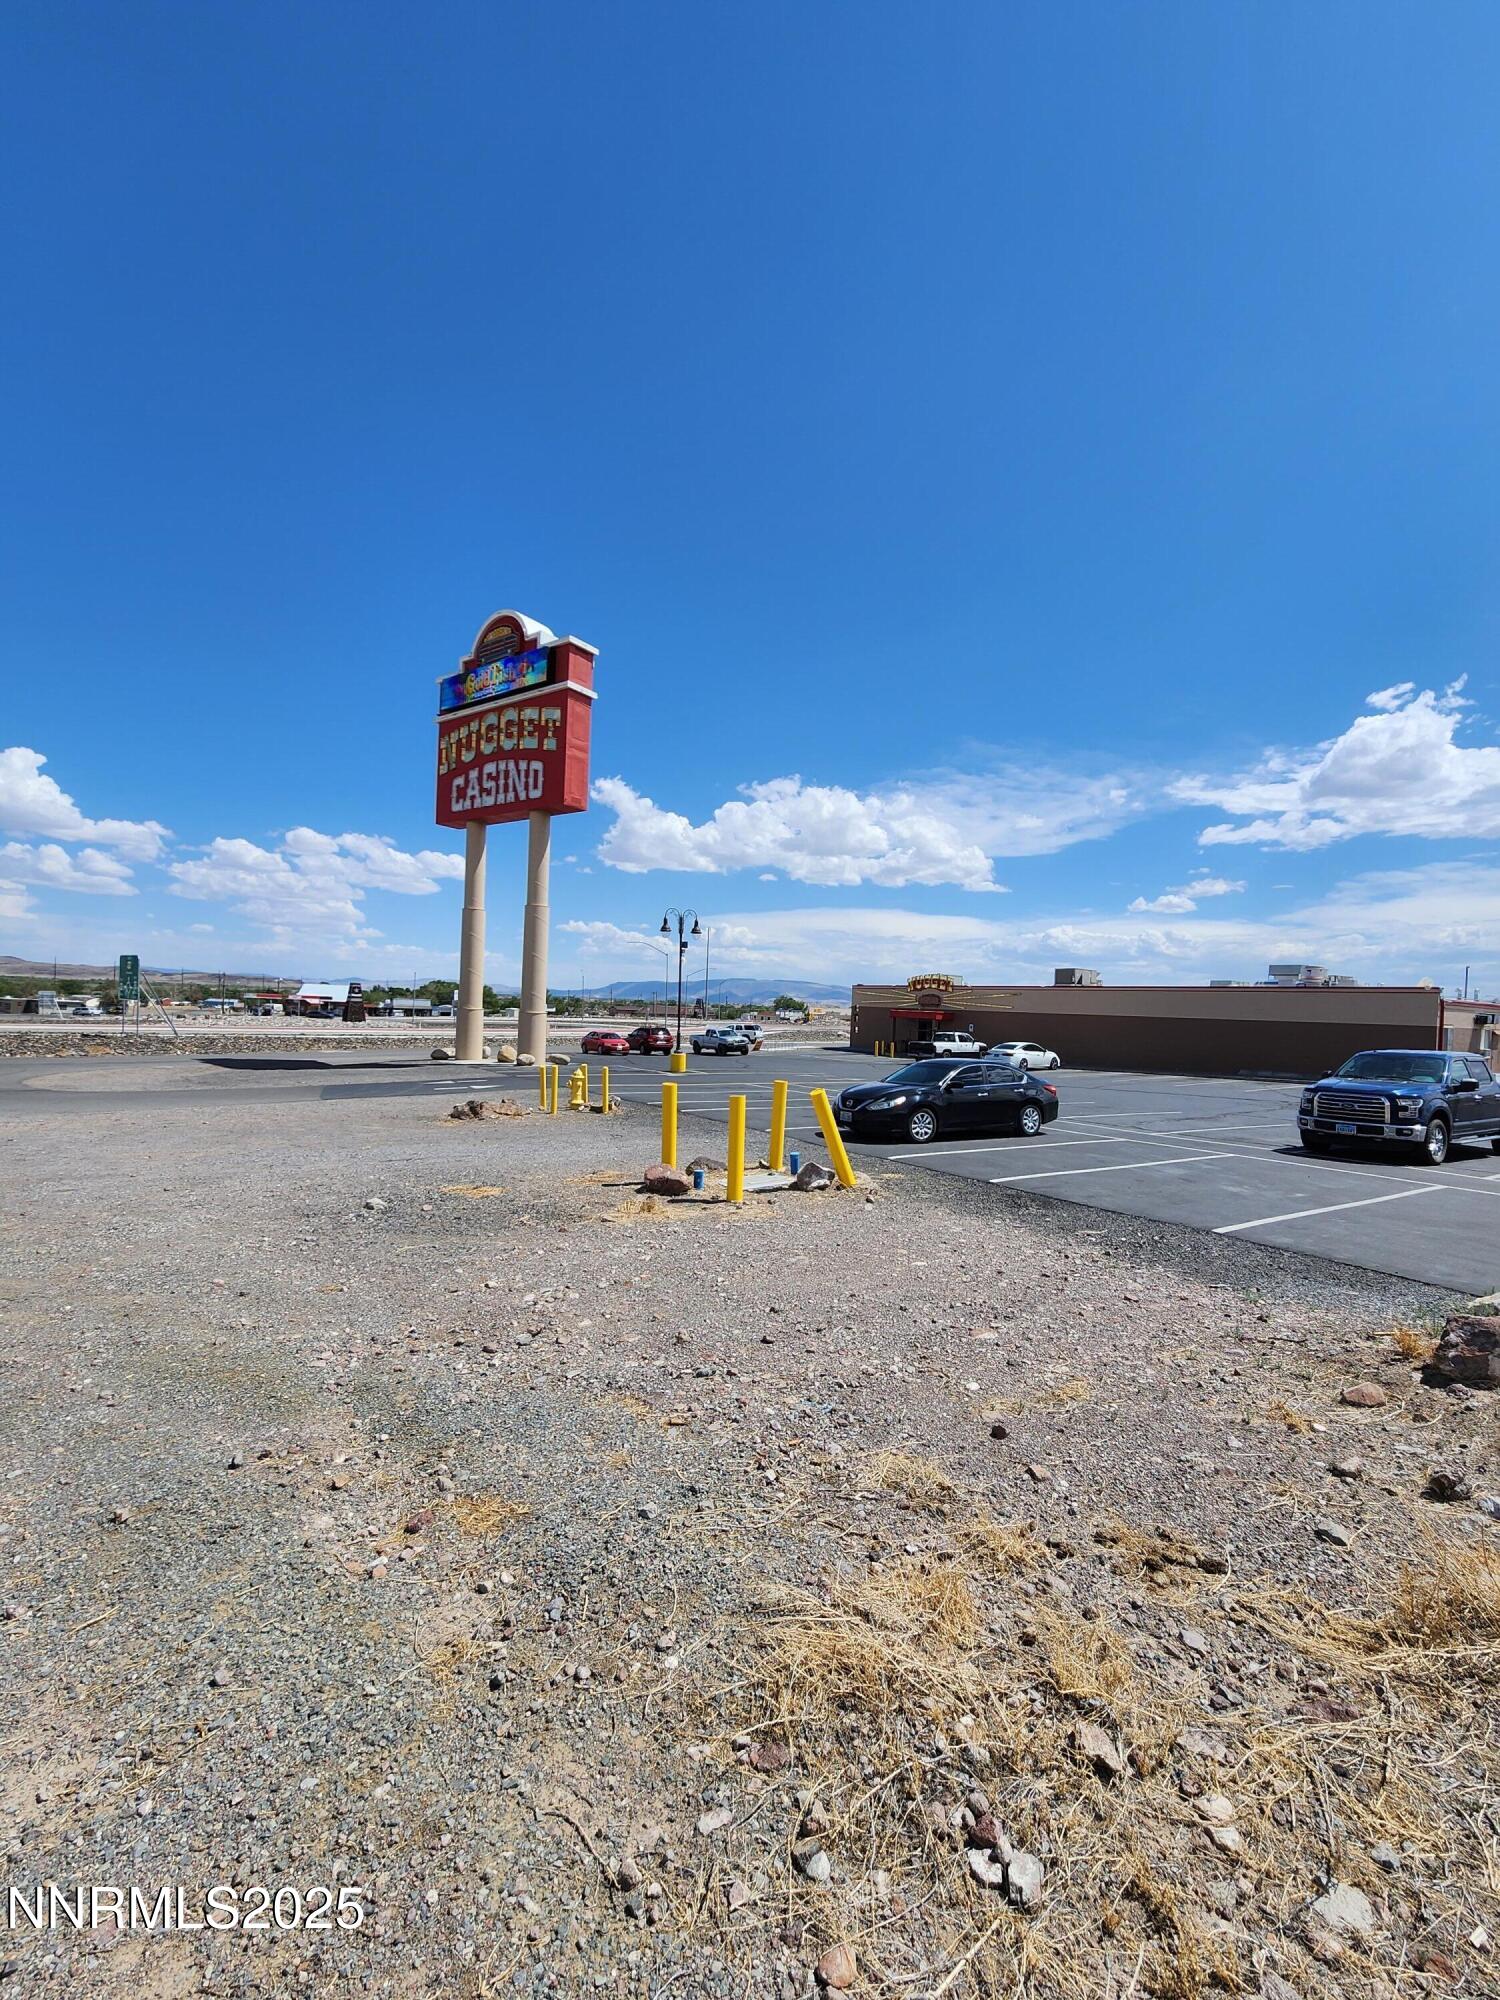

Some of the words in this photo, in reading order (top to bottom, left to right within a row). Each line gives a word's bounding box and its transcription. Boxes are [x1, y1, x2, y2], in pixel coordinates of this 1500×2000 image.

[439, 707, 561, 775] NUGGET
[451, 759, 544, 812] CASINO
[907, 973, 953, 992] NUGGET
